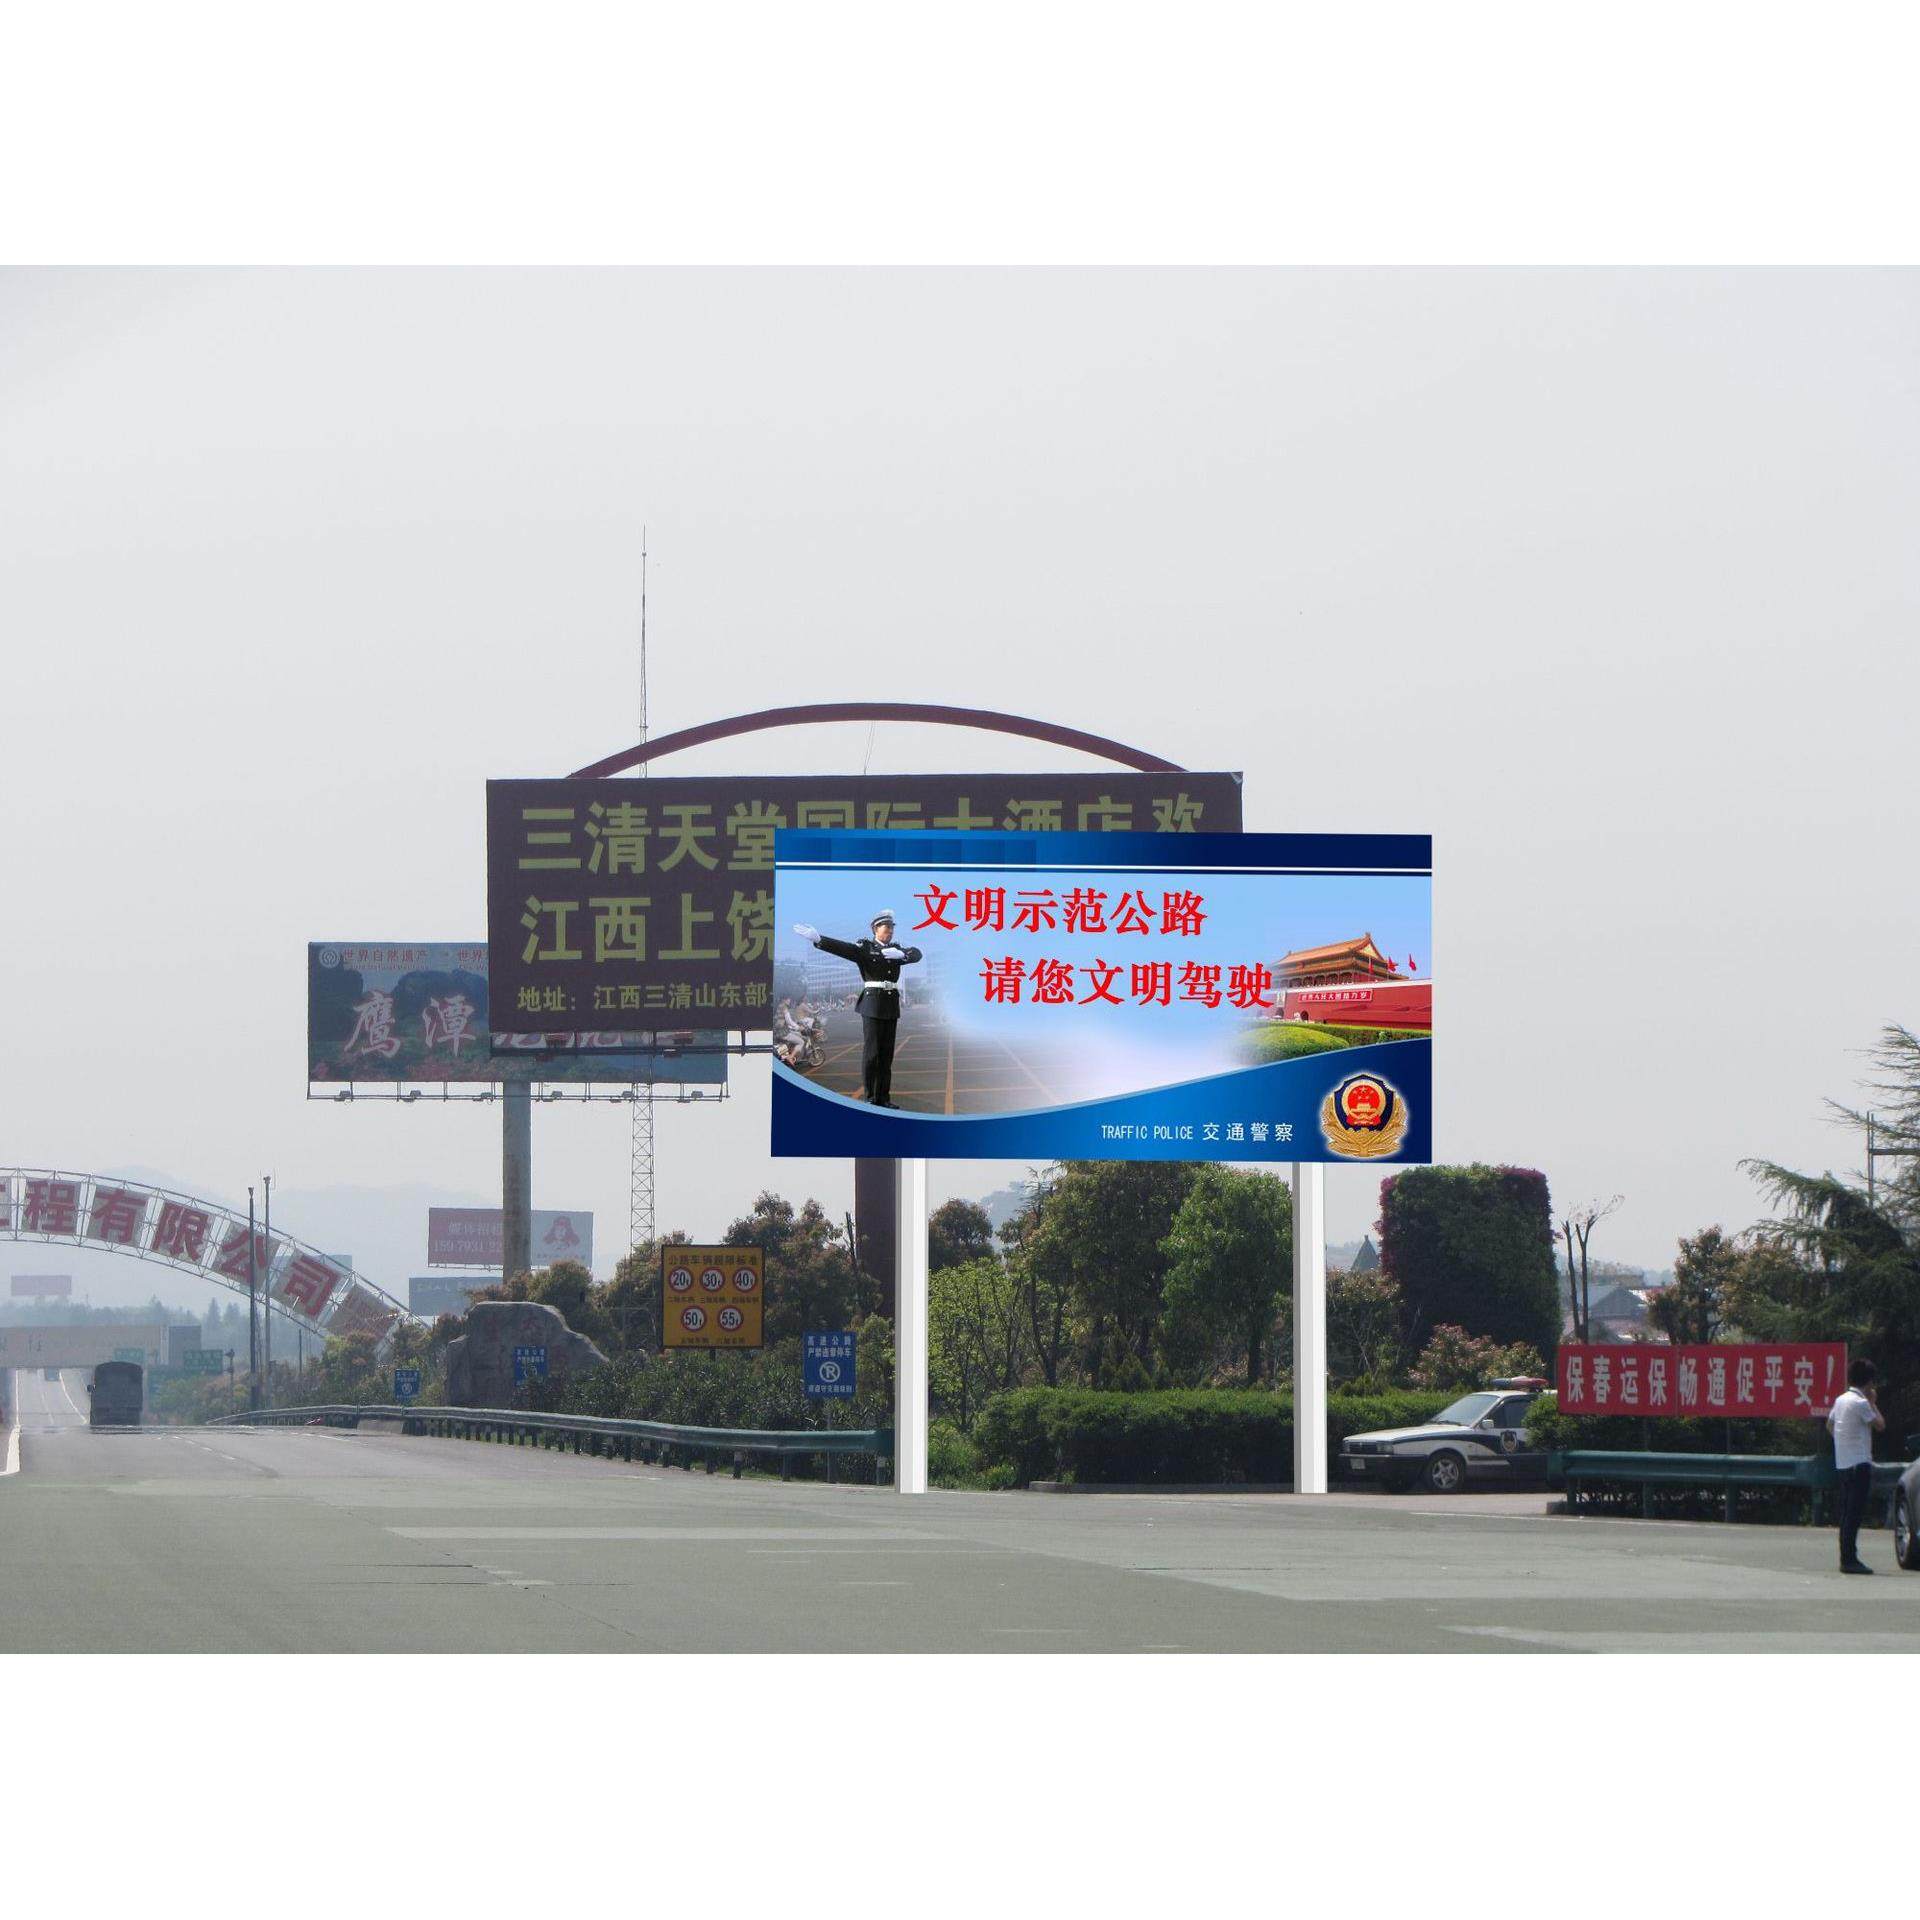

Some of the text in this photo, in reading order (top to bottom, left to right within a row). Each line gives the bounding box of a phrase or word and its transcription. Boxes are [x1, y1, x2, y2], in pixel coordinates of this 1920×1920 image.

[520, 889, 775, 964] 江西上饶
[912, 884, 1208, 937] 文明示范公路
[517, 981, 774, 1013] 地址：江西三清山东部
[979, 956, 1274, 1009] 请您文明驾驶
[1101, 1125, 1194, 1140] TRAFFIC POLICE
[1202, 1122, 1294, 1142] 交通警察
[0, 1179, 340, 1317] 程有限公司
